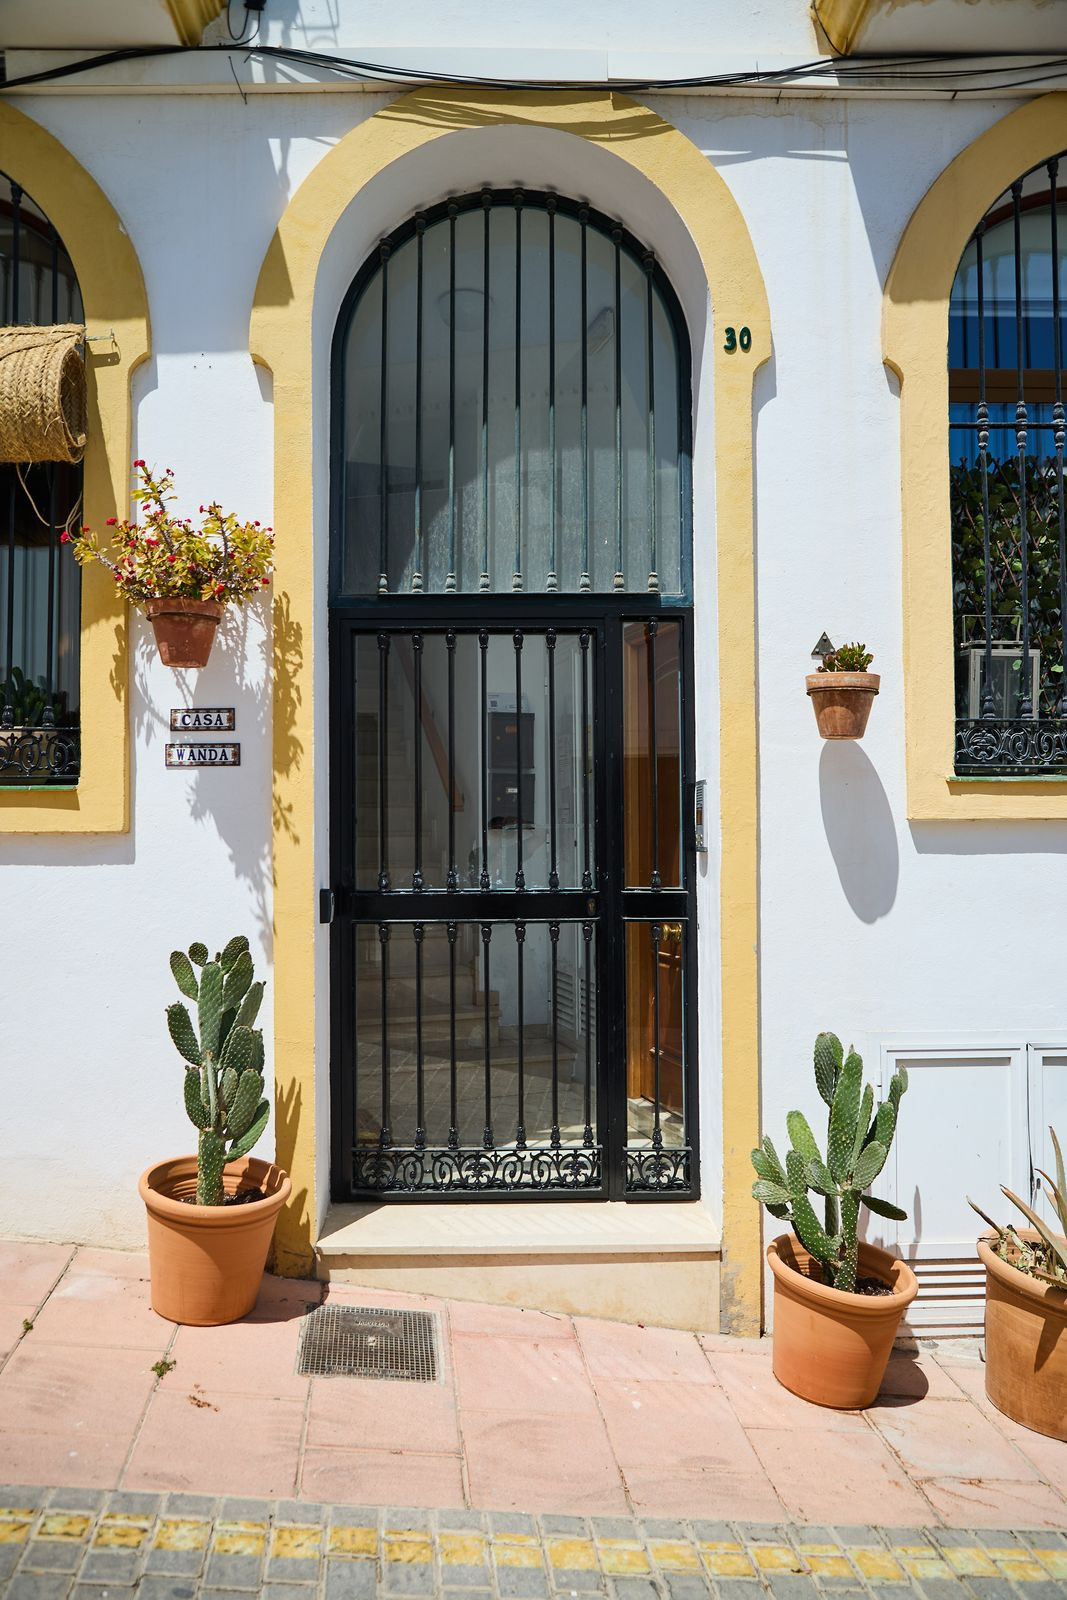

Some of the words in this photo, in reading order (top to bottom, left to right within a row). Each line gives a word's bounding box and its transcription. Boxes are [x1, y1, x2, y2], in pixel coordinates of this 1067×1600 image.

[724, 327, 751, 350] 30
[181, 713, 224, 726] CASA
[176, 748, 229, 761] WANDA
